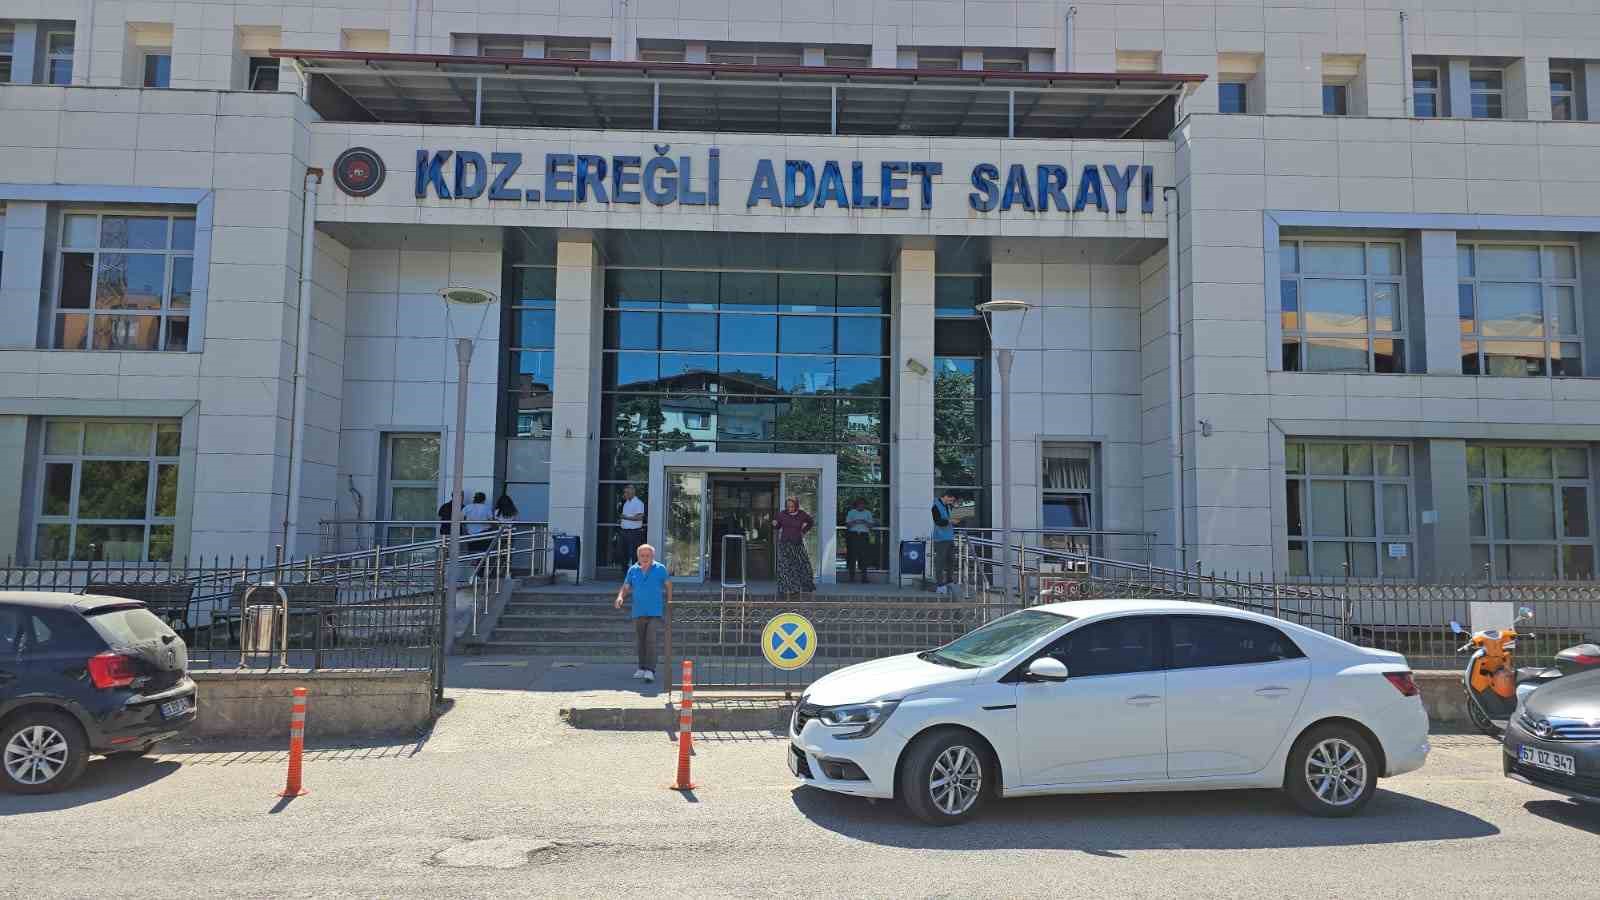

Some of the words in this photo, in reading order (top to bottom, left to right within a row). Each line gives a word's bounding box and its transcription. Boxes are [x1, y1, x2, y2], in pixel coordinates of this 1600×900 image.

[745, 157, 943, 211] ADALET
[968, 163, 1154, 214] SARAYI
[1553, 753, 1573, 770] 947
